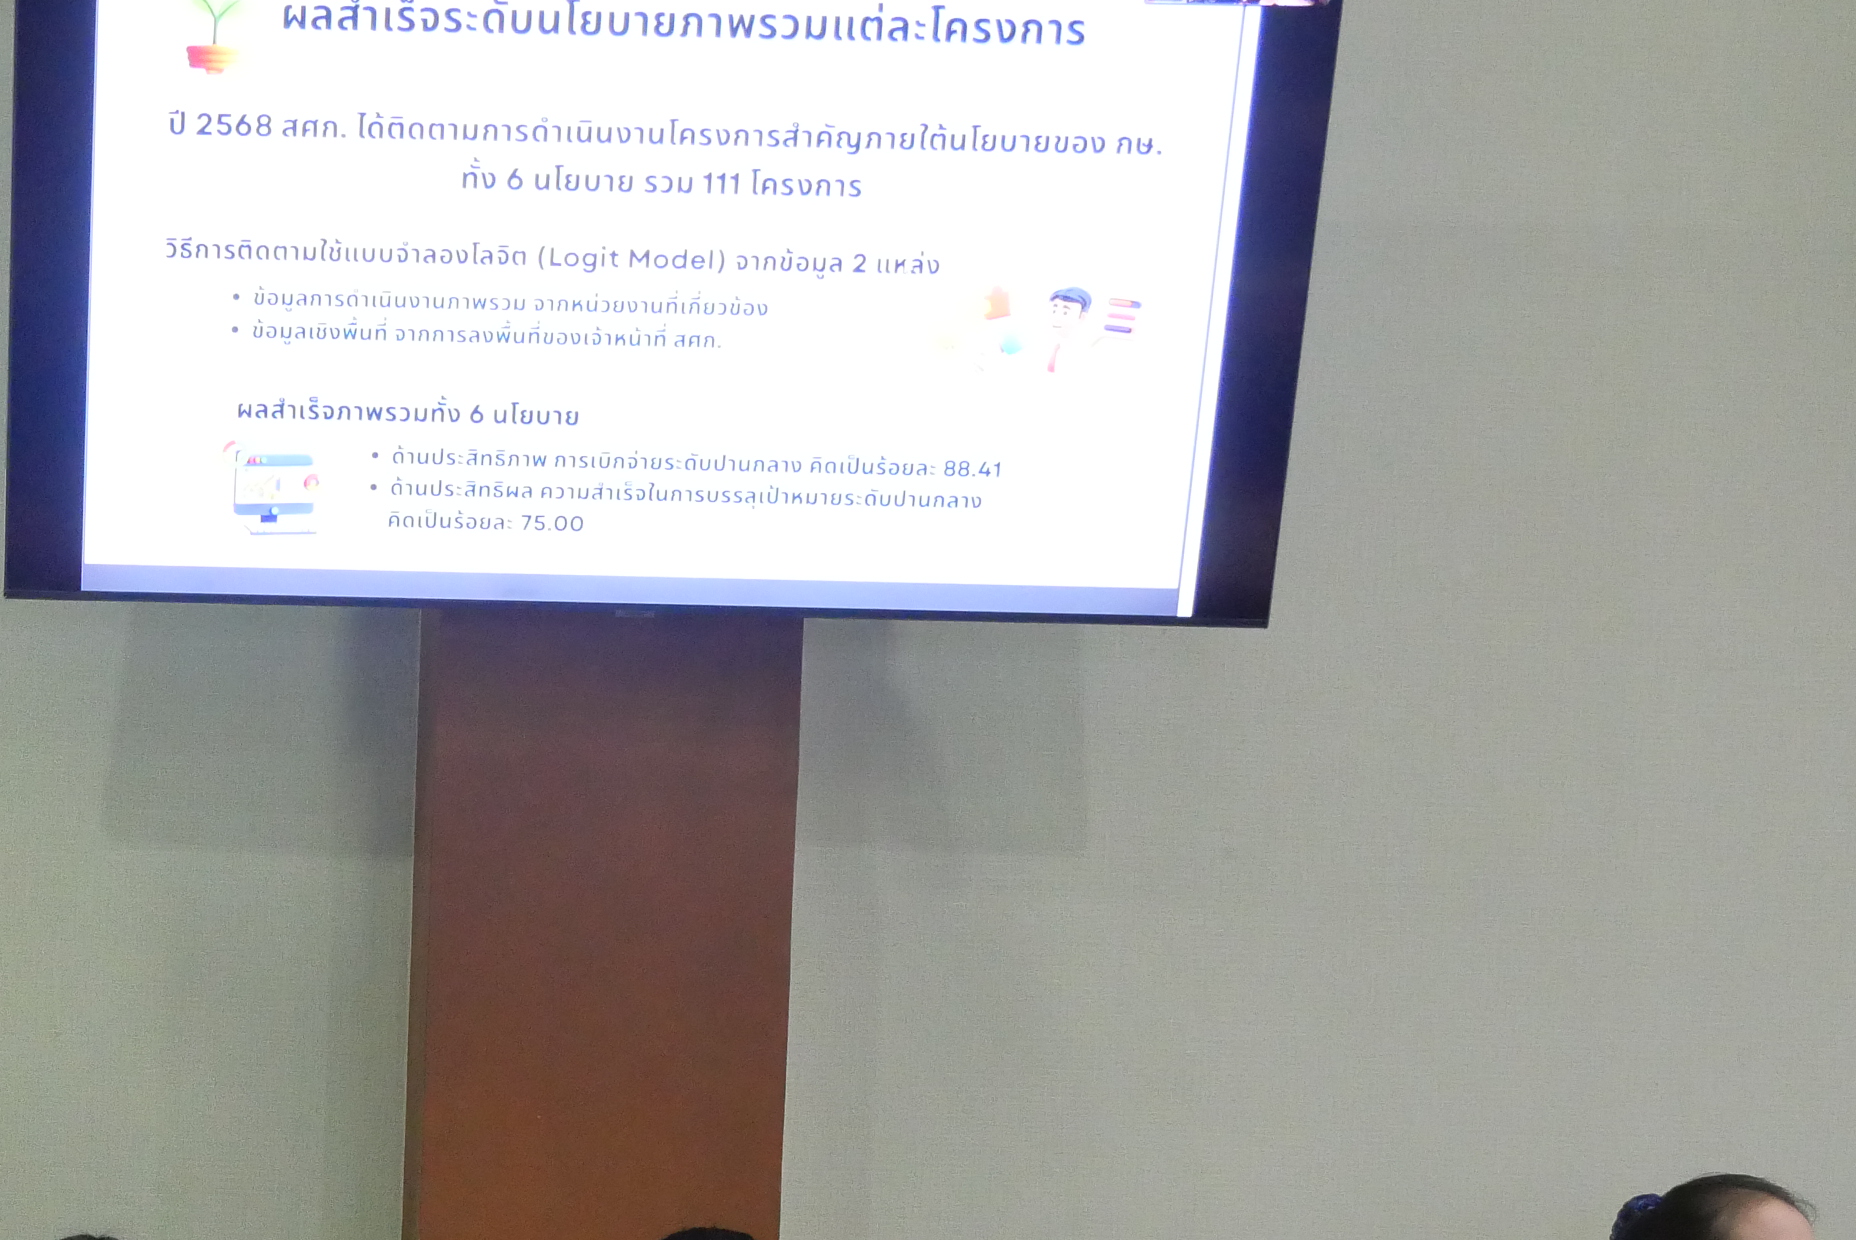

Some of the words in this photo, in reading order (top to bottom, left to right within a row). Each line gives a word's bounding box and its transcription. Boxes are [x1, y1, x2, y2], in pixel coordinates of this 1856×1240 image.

[168, 110, 186, 136] ปี
[195, 113, 272, 137] 2568
[281, 118, 347, 139] สศก.
[357, 112, 1106, 155] ได้ติดตามการดำเนินงานโครงการสำคัญภายใต้นโยบายของ
[1115, 136, 1162, 156] กษ.
[462, 157, 497, 190] ทั้ง
[506, 168, 524, 191] 6
[534, 164, 634, 193] นโยบาย
[644, 174, 694, 194] รวม
[702, 171, 740, 195] 111
[751, 168, 862, 198] โครงการ
[165, 236, 527, 266] วิธีการติดตามใช้แบบจำลองโลจิต
[538, 245, 619, 274] (Logit
[628, 248, 725, 274] Model)
[736, 248, 843, 280] จากข้อมูล
[852, 253, 867, 274] 2
[877, 251, 940, 275] แหล่ง
[253, 285, 526, 313] ข้อมูลการดำเนินงานภาพรวม
[534, 290, 769, 317] จากหน่วยงานที่เกี่ยวข้อง
[252, 316, 387, 346] ข้อมูลเชิงพื้นที่
[673, 334, 722, 349] สศก.
[237, 395, 461, 424] ผลสำเร็จภาพรวมทั้ง
[469, 405, 485, 424] 6
[493, 402, 579, 427] นโยบาย
[392, 444, 548, 468] ด้านประสิทธิภาพ
[554, 449, 802, 474] การเบิกจ่ายระดับปานกลาง
[809, 454, 937, 478] คิดเป็นร้อยละ
[943, 460, 1002, 478] 88.41
[390, 476, 533, 500] ด้านประสิทธิผล
[388, 509, 514, 531] คิดเป็นร้อยละ
[521, 514, 584, 532] 75.00
